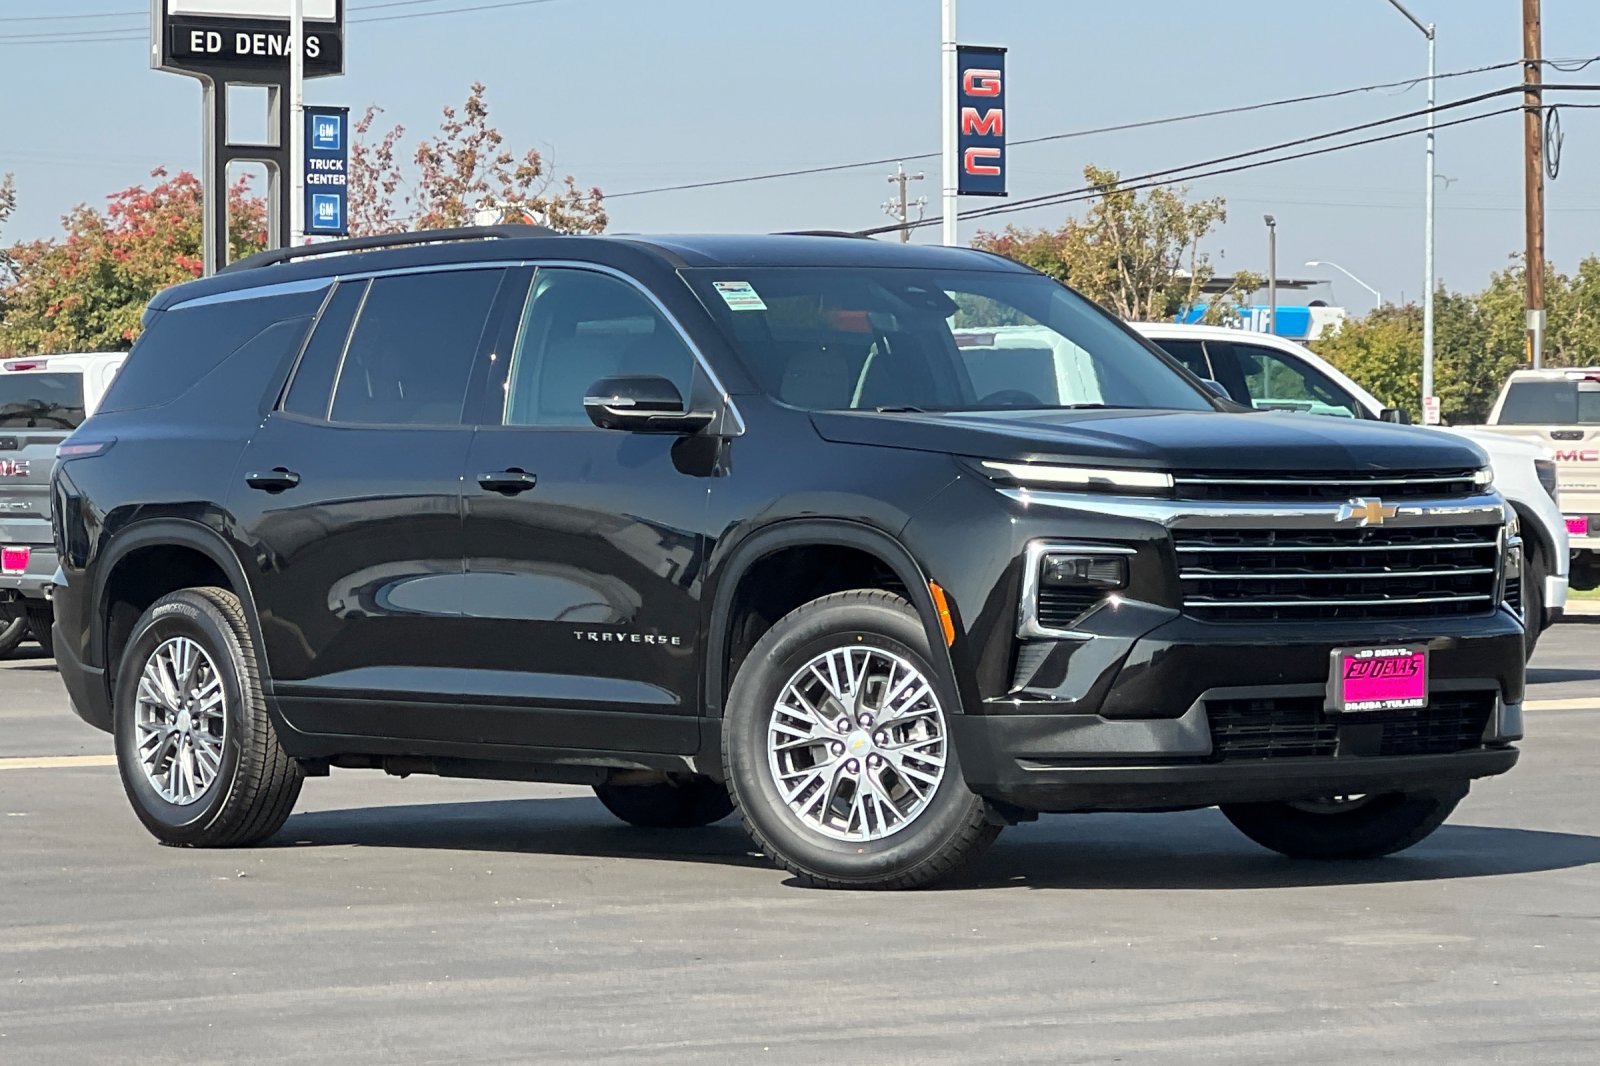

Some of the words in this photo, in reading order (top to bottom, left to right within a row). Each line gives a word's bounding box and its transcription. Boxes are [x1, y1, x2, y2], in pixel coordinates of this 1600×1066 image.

[190, 31, 222, 53] ED
[961, 68, 1004, 176] GMC
[319, 123, 334, 141] GM
[309, 158, 344, 171] TRUCK
[306, 173, 347, 185] CENTER
[319, 202, 334, 220] GM
[1552, 449, 1599, 461] MC
[573, 631, 681, 646] TRAVERSE
[1360, 650, 1373, 658] ED
[1344, 660, 1371, 679] ED
